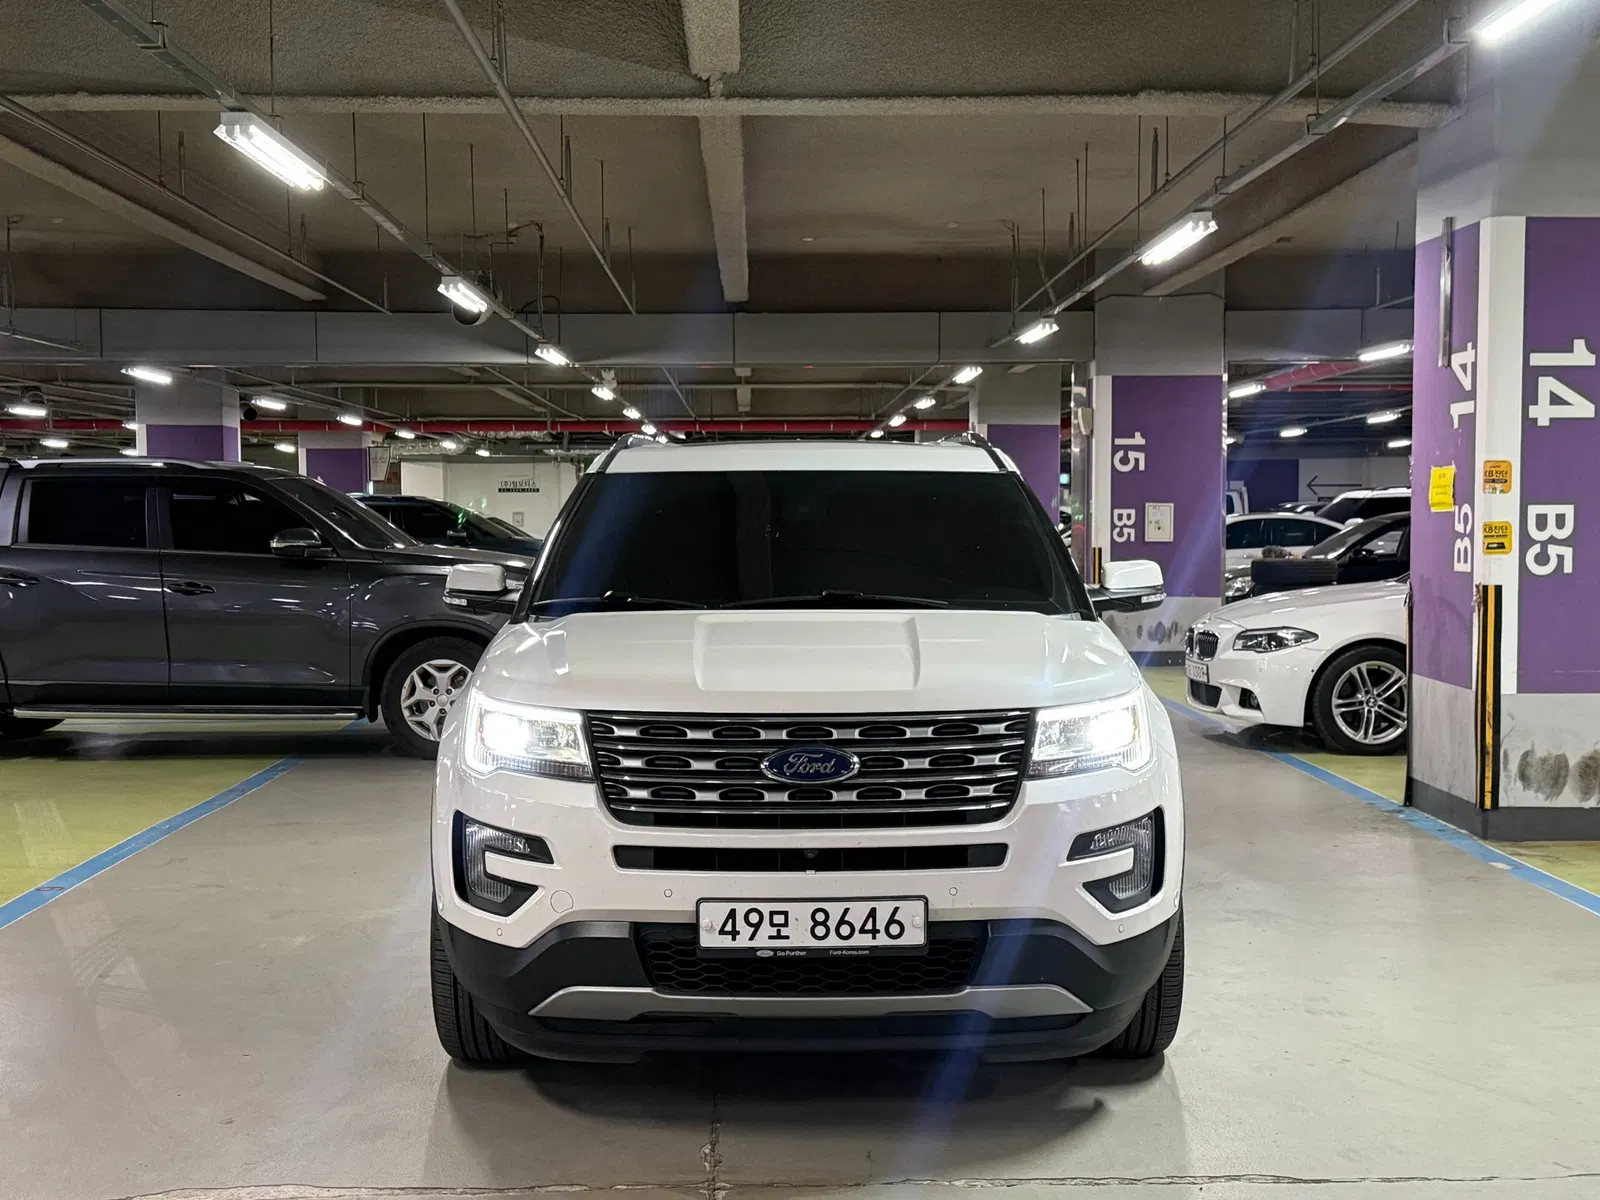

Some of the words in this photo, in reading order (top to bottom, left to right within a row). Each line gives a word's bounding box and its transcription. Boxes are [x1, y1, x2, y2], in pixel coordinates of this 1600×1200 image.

[1450, 341, 1476, 429] 14
[1528, 338, 1596, 427] 14
[1113, 431, 1146, 473] 15
[1112, 508, 1136, 543] B5
[1453, 503, 1472, 573] B5
[1525, 504, 1575, 576] B5
[784, 753, 837, 774] Ford
[718, 907, 790, 942] 49모
[810, 906, 906, 941] 8646
